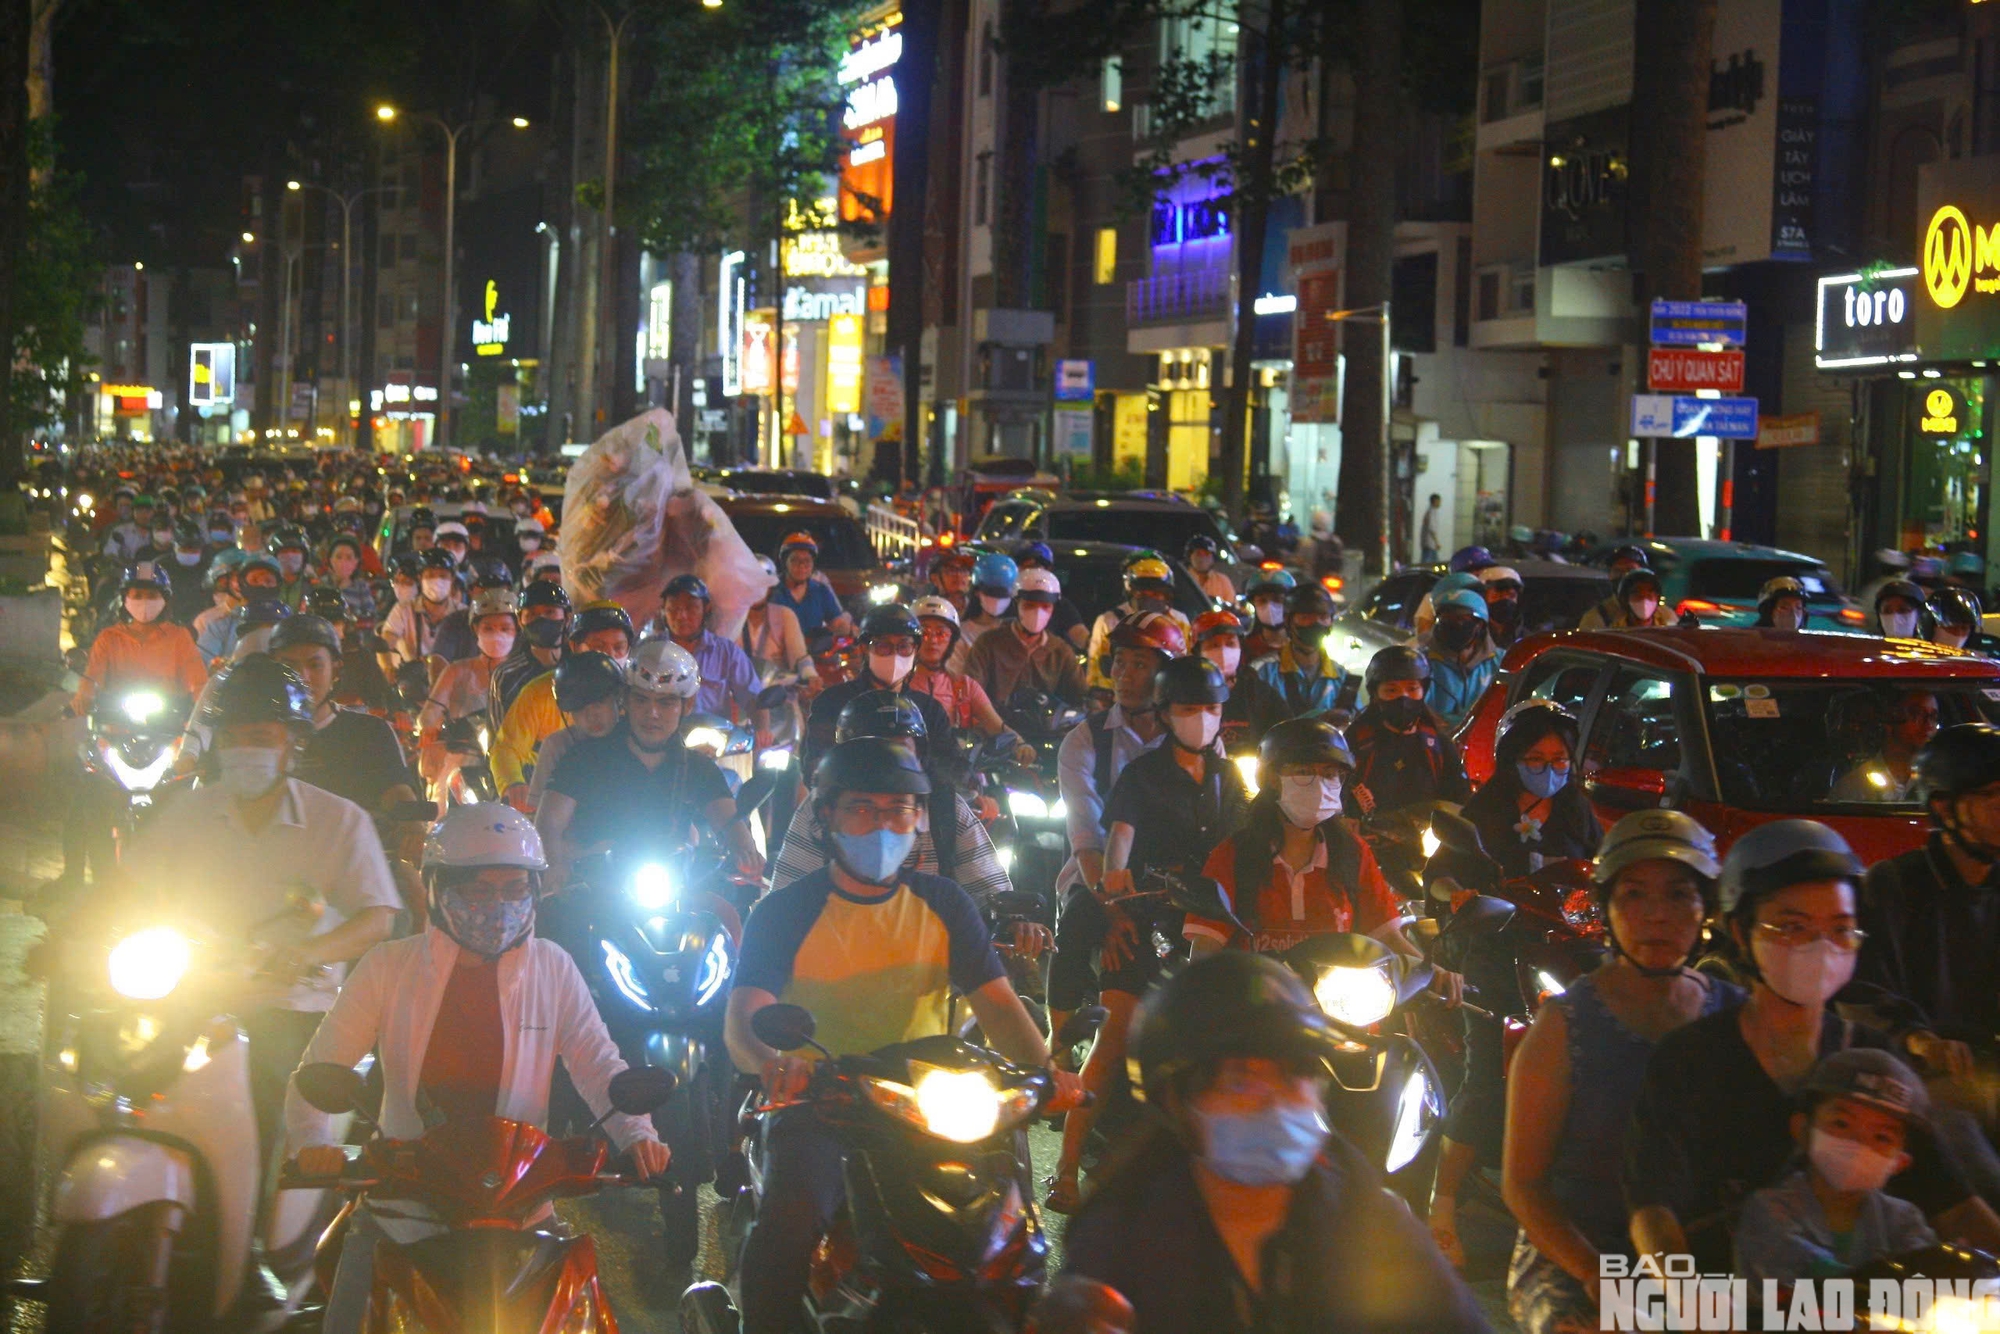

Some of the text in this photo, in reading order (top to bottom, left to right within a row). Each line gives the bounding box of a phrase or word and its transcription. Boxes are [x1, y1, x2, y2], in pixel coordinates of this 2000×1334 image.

[1845, 285, 1905, 327] toro
[1652, 354, 1740, 382] CHÚ Ý QUAN SÁT
